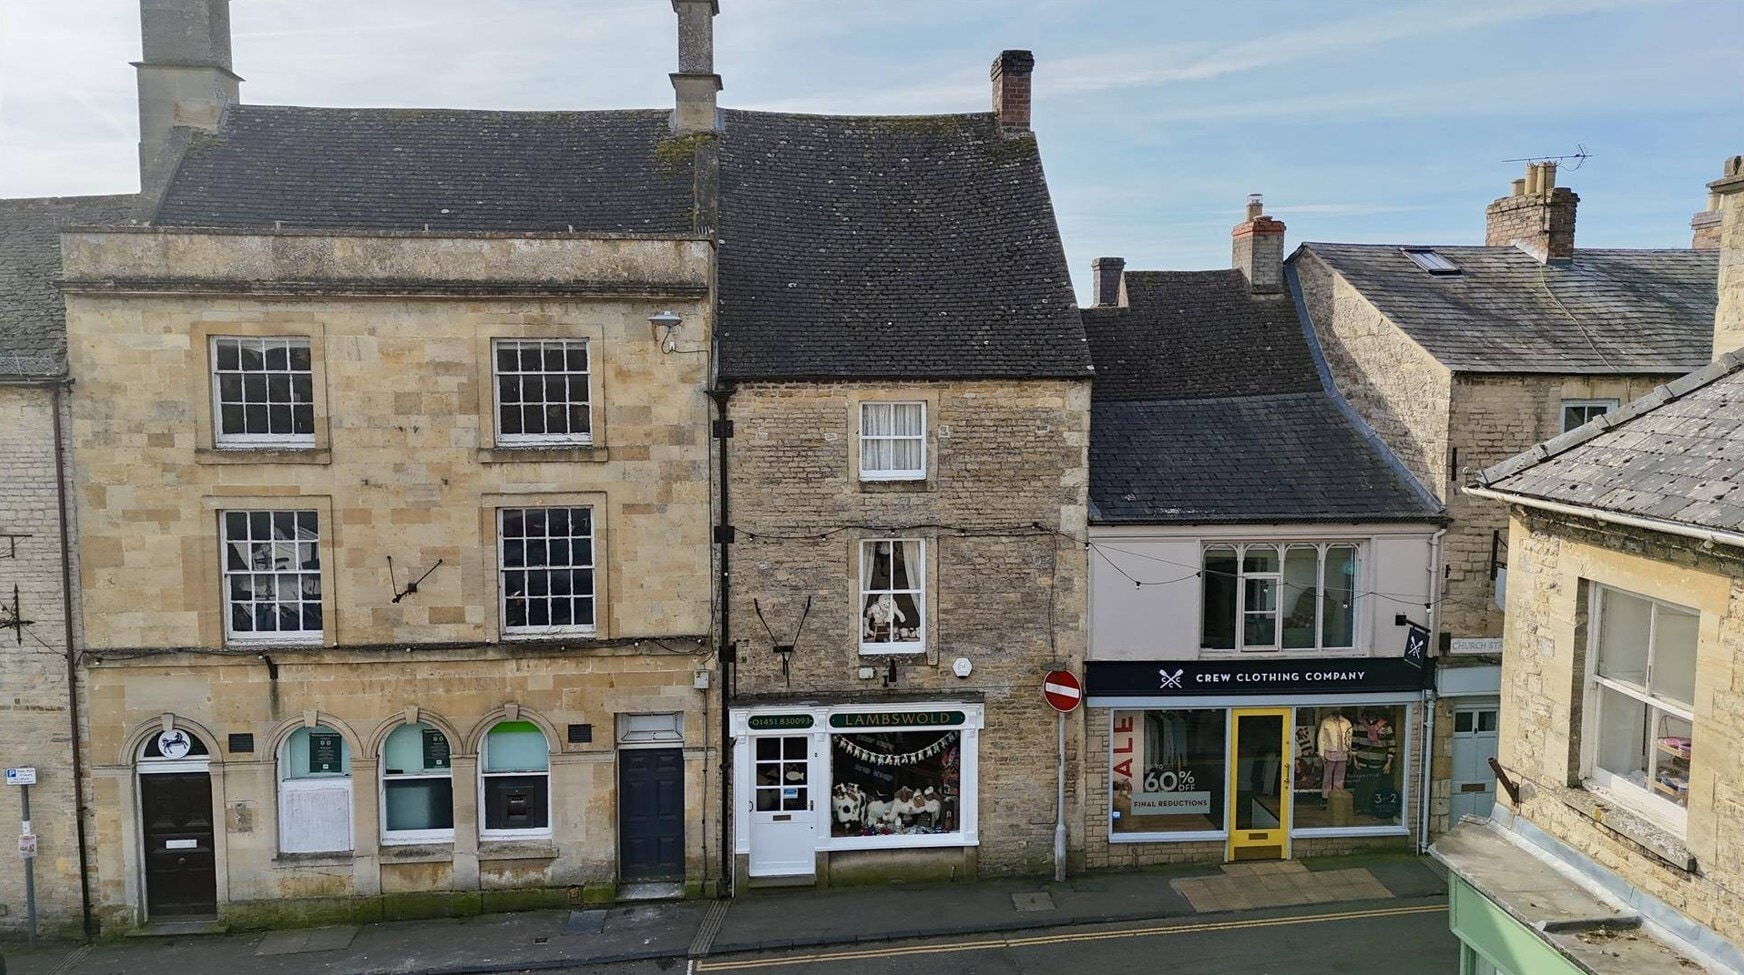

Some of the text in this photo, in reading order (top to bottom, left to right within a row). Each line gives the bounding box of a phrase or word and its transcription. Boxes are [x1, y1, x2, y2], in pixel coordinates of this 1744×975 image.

[1452, 641, 1487, 650] CHURCH
[1196, 671, 1366, 683] CREW CLOTHING COMPANY
[752, 717, 810, 726] 01451 830093
[845, 712, 950, 726] LAMBSWOLD
[1144, 770, 1195, 792] 60%
[1178, 784, 1195, 792] OFF
[1374, 793, 1382, 804] 3
[1390, 793, 1397, 804] 2
